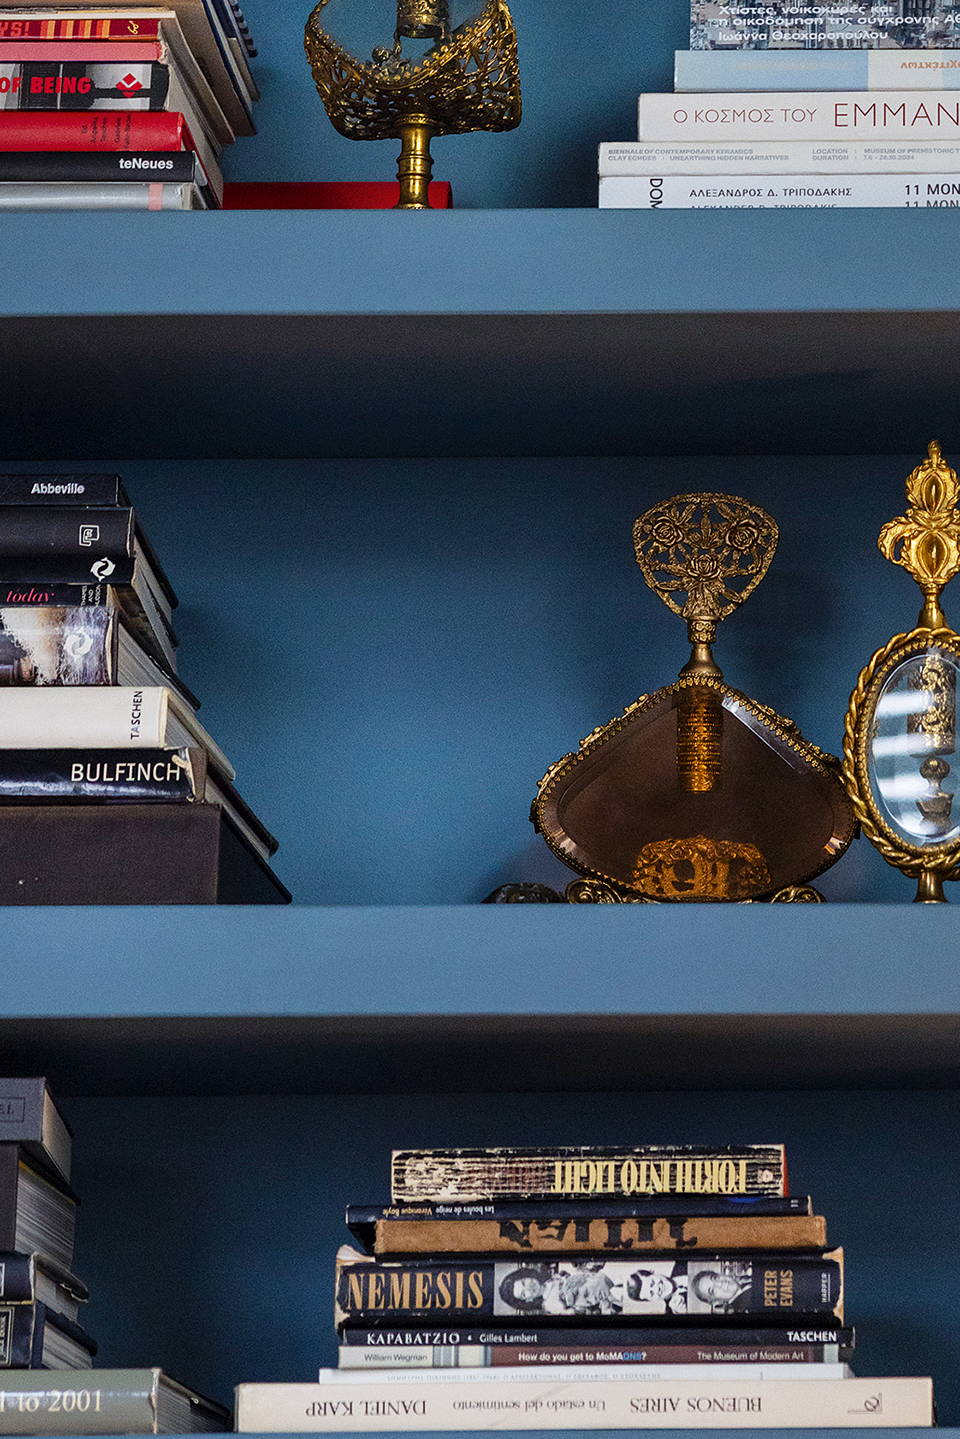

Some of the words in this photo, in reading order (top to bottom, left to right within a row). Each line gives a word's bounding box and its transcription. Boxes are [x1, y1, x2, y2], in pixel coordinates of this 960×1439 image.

[718, 31, 768, 41] Ιωάννα
[0, 77, 22, 93] OF
[30, 76, 91, 94] BEING
[673, 109, 688, 123] Ο
[694, 109, 774, 123] ΚΟΣΜΟΣ
[780, 108, 818, 122] ΤΟΥ
[119, 157, 174, 170] teNeues
[689, 188, 763, 197] ΑΛΕΞΑΝΔΡΟΣ
[767, 188, 779, 197] Δ.
[782, 187, 852, 197] ΤΡΙΠΟΔΑΚΗΣ
[905, 184, 920, 195] 11
[31, 483, 85, 495] Abbeville
[6, 587, 54, 606] today
[130, 690, 143, 740] TASCHEN
[71, 763, 181, 782] BULFINCH
[551, 1160, 615, 1194] LIGHT
[622, 1160, 671, 1193] INTO
[676, 1159, 747, 1193] FORTH
[463, 1205, 483, 1215] boules
[484, 1205, 494, 1214] Les
[346, 1271, 484, 1311] NEMESIS
[764, 1269, 778, 1308] PETER
[780, 1269, 793, 1307] EVANS
[367, 1332, 461, 1345] ΚΑΡΑΒΑΤΖΙΟ
[479, 1333, 502, 1344] Gilles
[504, 1333, 538, 1343] Lambert
[787, 1331, 837, 1342] TASCHEN
[364, 1353, 393, 1361] William
[393, 1353, 427, 1363] Wegman
[518, 1352, 538, 1361] How
[539, 1352, 550, 1361] do
[552, 1353, 568, 1363] you
[569, 1352, 584, 1363] get
[585, 1352, 594, 1360] to
[697, 1351, 711, 1360] The
[713, 1351, 747, 1360] Museum
[750, 1351, 758, 1360] of
[759, 1351, 789, 1360] Modern
[791, 1351, 804, 1360] Art
[19, 1391, 40, 1413] to
[48, 1389, 102, 1413] 2001
[452, 1400, 521, 1411] sentimiento
[524, 1401, 543, 1412] del
[546, 1400, 585, 1411] estado
[588, 1400, 606, 1411] Un
[629, 1397, 680, 1413] AIRES
[687, 1397, 763, 1413] BUENOS
[305, 1401, 354, 1417] KARP
[360, 1400, 427, 1416] DANIEL
